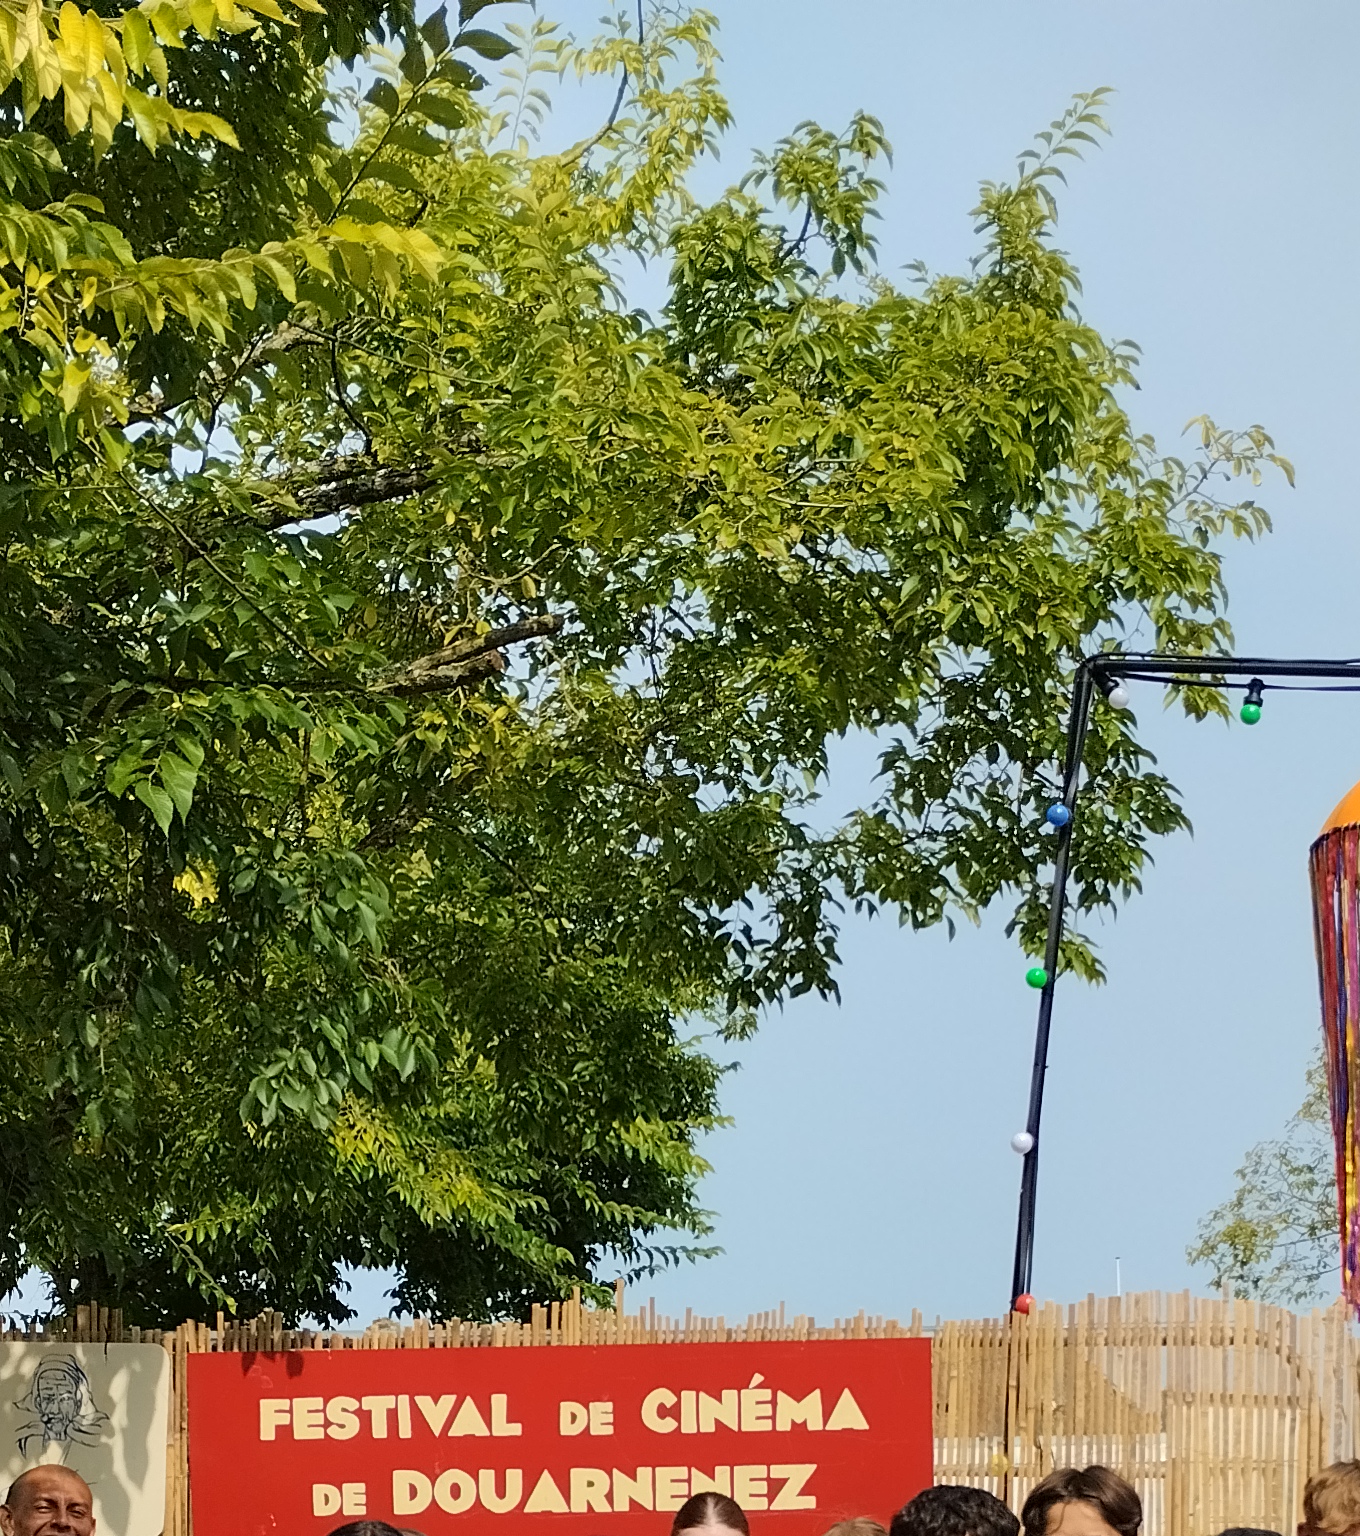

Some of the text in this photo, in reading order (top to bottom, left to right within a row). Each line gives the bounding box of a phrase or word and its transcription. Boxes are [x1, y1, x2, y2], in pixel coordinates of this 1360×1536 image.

[259, 1372, 870, 1441] FESTIVAL DE CINÉMA
[312, 1463, 818, 1517] DE DOUARNENEZ
